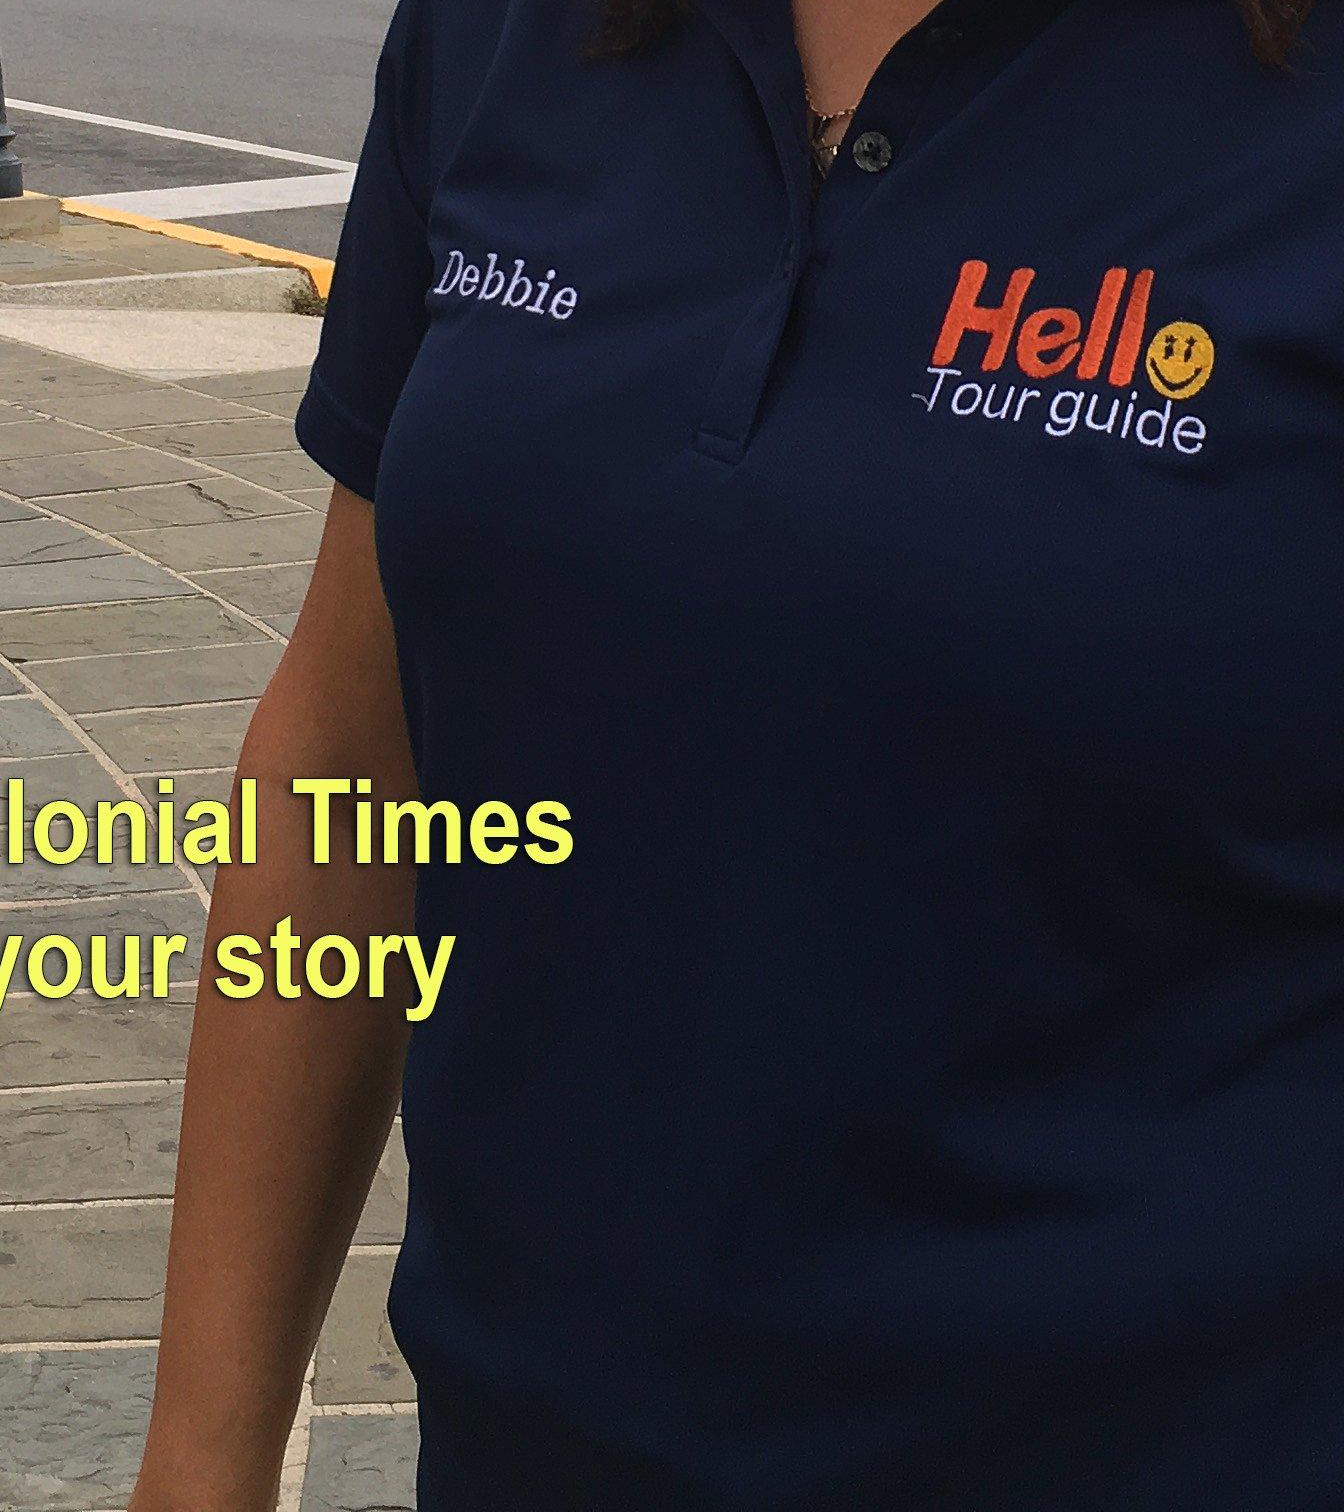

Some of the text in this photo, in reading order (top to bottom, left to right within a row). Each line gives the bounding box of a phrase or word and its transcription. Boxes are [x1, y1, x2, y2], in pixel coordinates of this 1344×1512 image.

[433, 249, 578, 320] Debbie
[924, 366, 1208, 455] Tour guide
